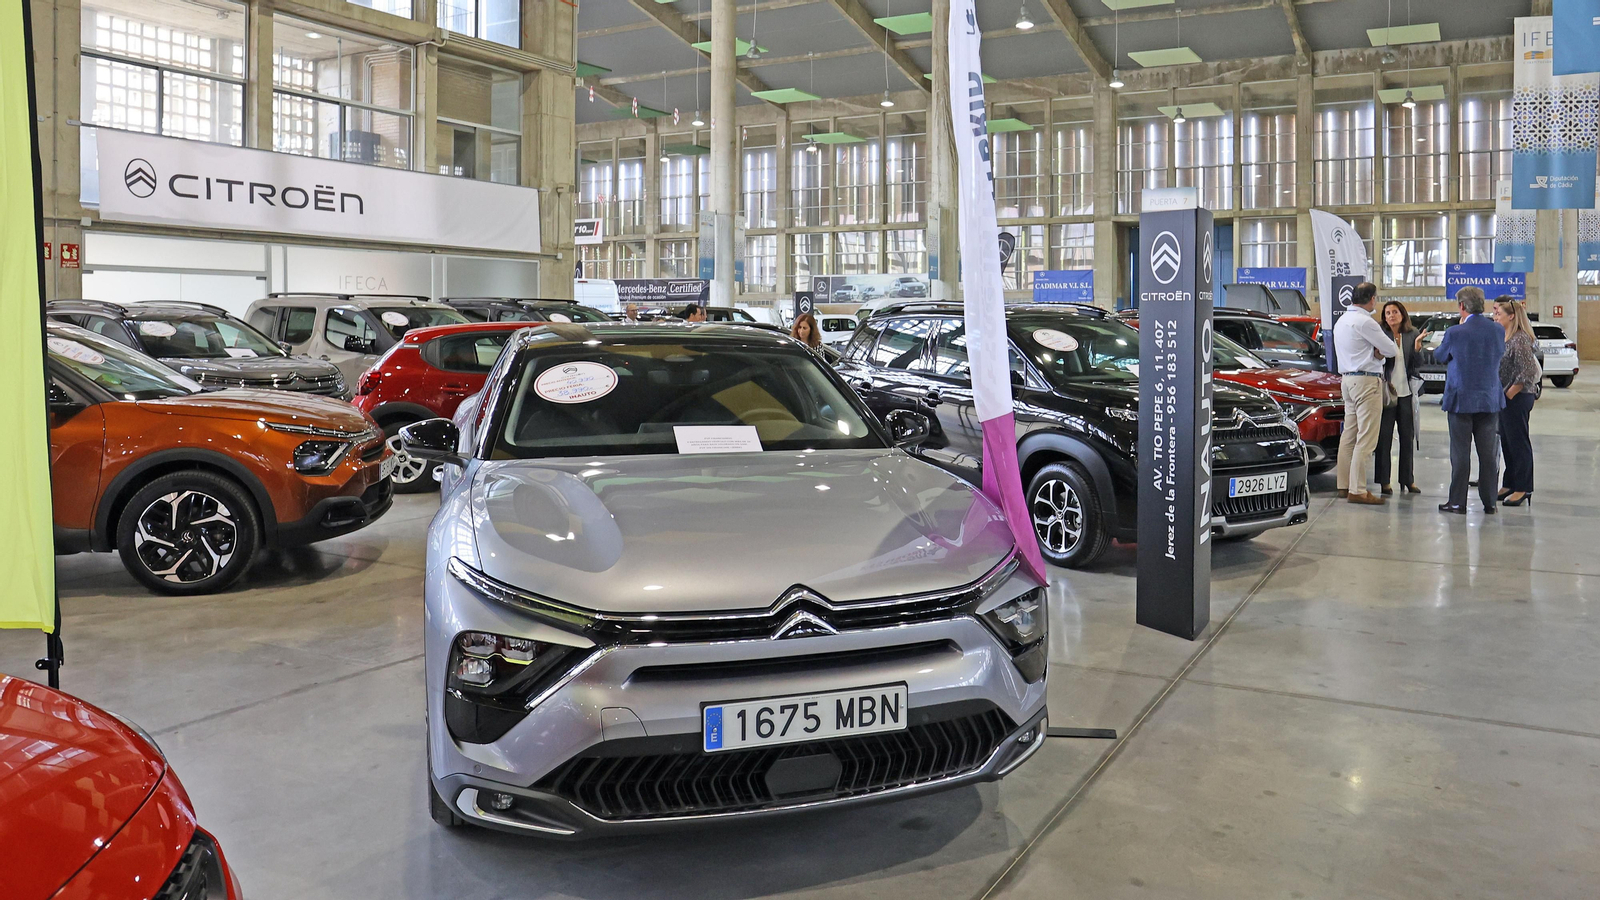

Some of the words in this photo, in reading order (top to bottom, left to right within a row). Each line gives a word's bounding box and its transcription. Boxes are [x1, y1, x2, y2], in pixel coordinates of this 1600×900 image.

[1523, 31, 1553, 47] IFE
[1150, 197, 1178, 206] PUERTA
[1183, 197, 1188, 205] 7
[338, 275, 388, 291] IFECA
[669, 283, 702, 293] Certified
[1034, 282, 1068, 290] CADIMAR
[1447, 277, 1491, 285] CADIMAR
[1167, 320, 1177, 348] 512
[1154, 320, 1164, 371] 11.407
[1167, 353, 1177, 380] 183
[544, 386, 566, 394] PRECIO
[1154, 378, 1164, 392] 6,
[569, 391, 597, 399] INAUTO
[1167, 386, 1177, 414] 956
[1154, 396, 1164, 432] PEPE
[1200, 319, 1212, 545] INAUTO
[1153, 435, 1163, 461] TIO
[1166, 427, 1176, 485] Frontera
[1153, 465, 1163, 491] AV.
[1237, 477, 1265, 494] 2926
[1267, 475, 1286, 491] LYZ
[1165, 489, 1175, 501] la
[1165, 505, 1175, 522] de
[1165, 525, 1176, 560] Jerez
[736, 701, 821, 742] 1675
[835, 692, 900, 731] MBN
[710, 732, 718, 743] E
